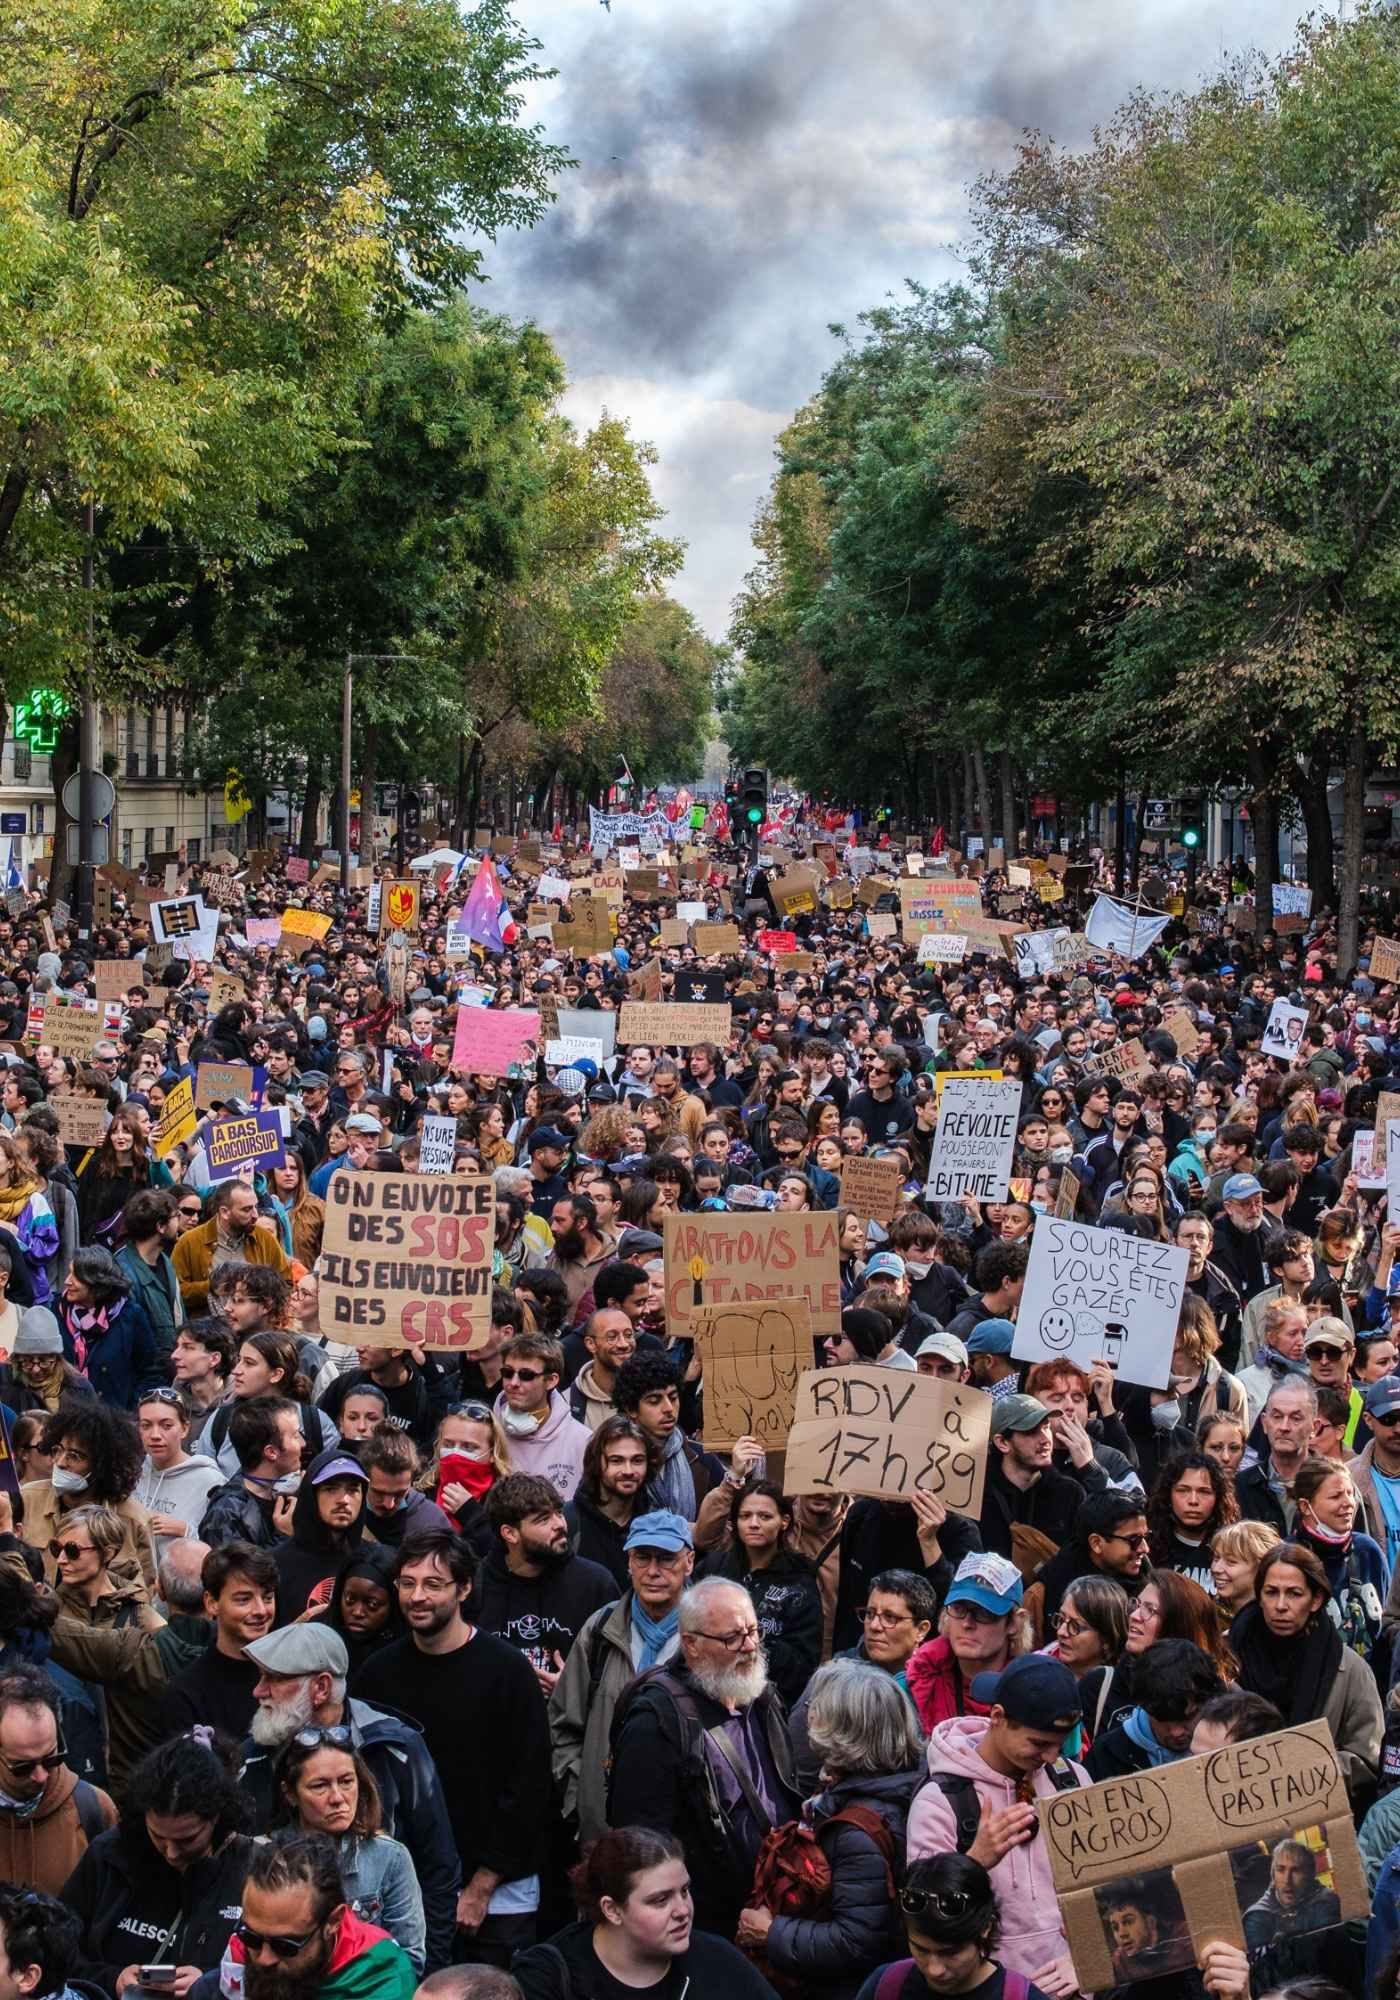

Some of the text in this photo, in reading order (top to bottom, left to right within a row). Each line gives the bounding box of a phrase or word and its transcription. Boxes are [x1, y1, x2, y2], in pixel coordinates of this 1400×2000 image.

[211, 1131, 276, 1164] PARCOURSUP
[215, 1121, 257, 1142] À BAS
[942, 1108, 1015, 1138] RÉVOLTE
[940, 1140, 1008, 1156] POUSSERONT
[334, 1176, 492, 1216] ON ENVOIE
[348, 1213, 489, 1263] DES SOS
[672, 1222, 837, 1271] ABATTONS LA
[1048, 1222, 1172, 1271] SOURIEZ
[321, 1253, 371, 1289] ILS
[1053, 1257, 1180, 1309] VOUS ÊTES
[334, 1296, 473, 1346] DES CRS
[1052, 1283, 1137, 1318] GAZÉS
[810, 1377, 969, 1442] RDV à
[812, 1429, 976, 1508] 17h89
[1211, 1740, 1284, 1785] C'EST
[1050, 1779, 1144, 1828] ON EN
[1221, 1764, 1333, 1820] PAS FAUX
[1070, 1805, 1164, 1857] AGROS
